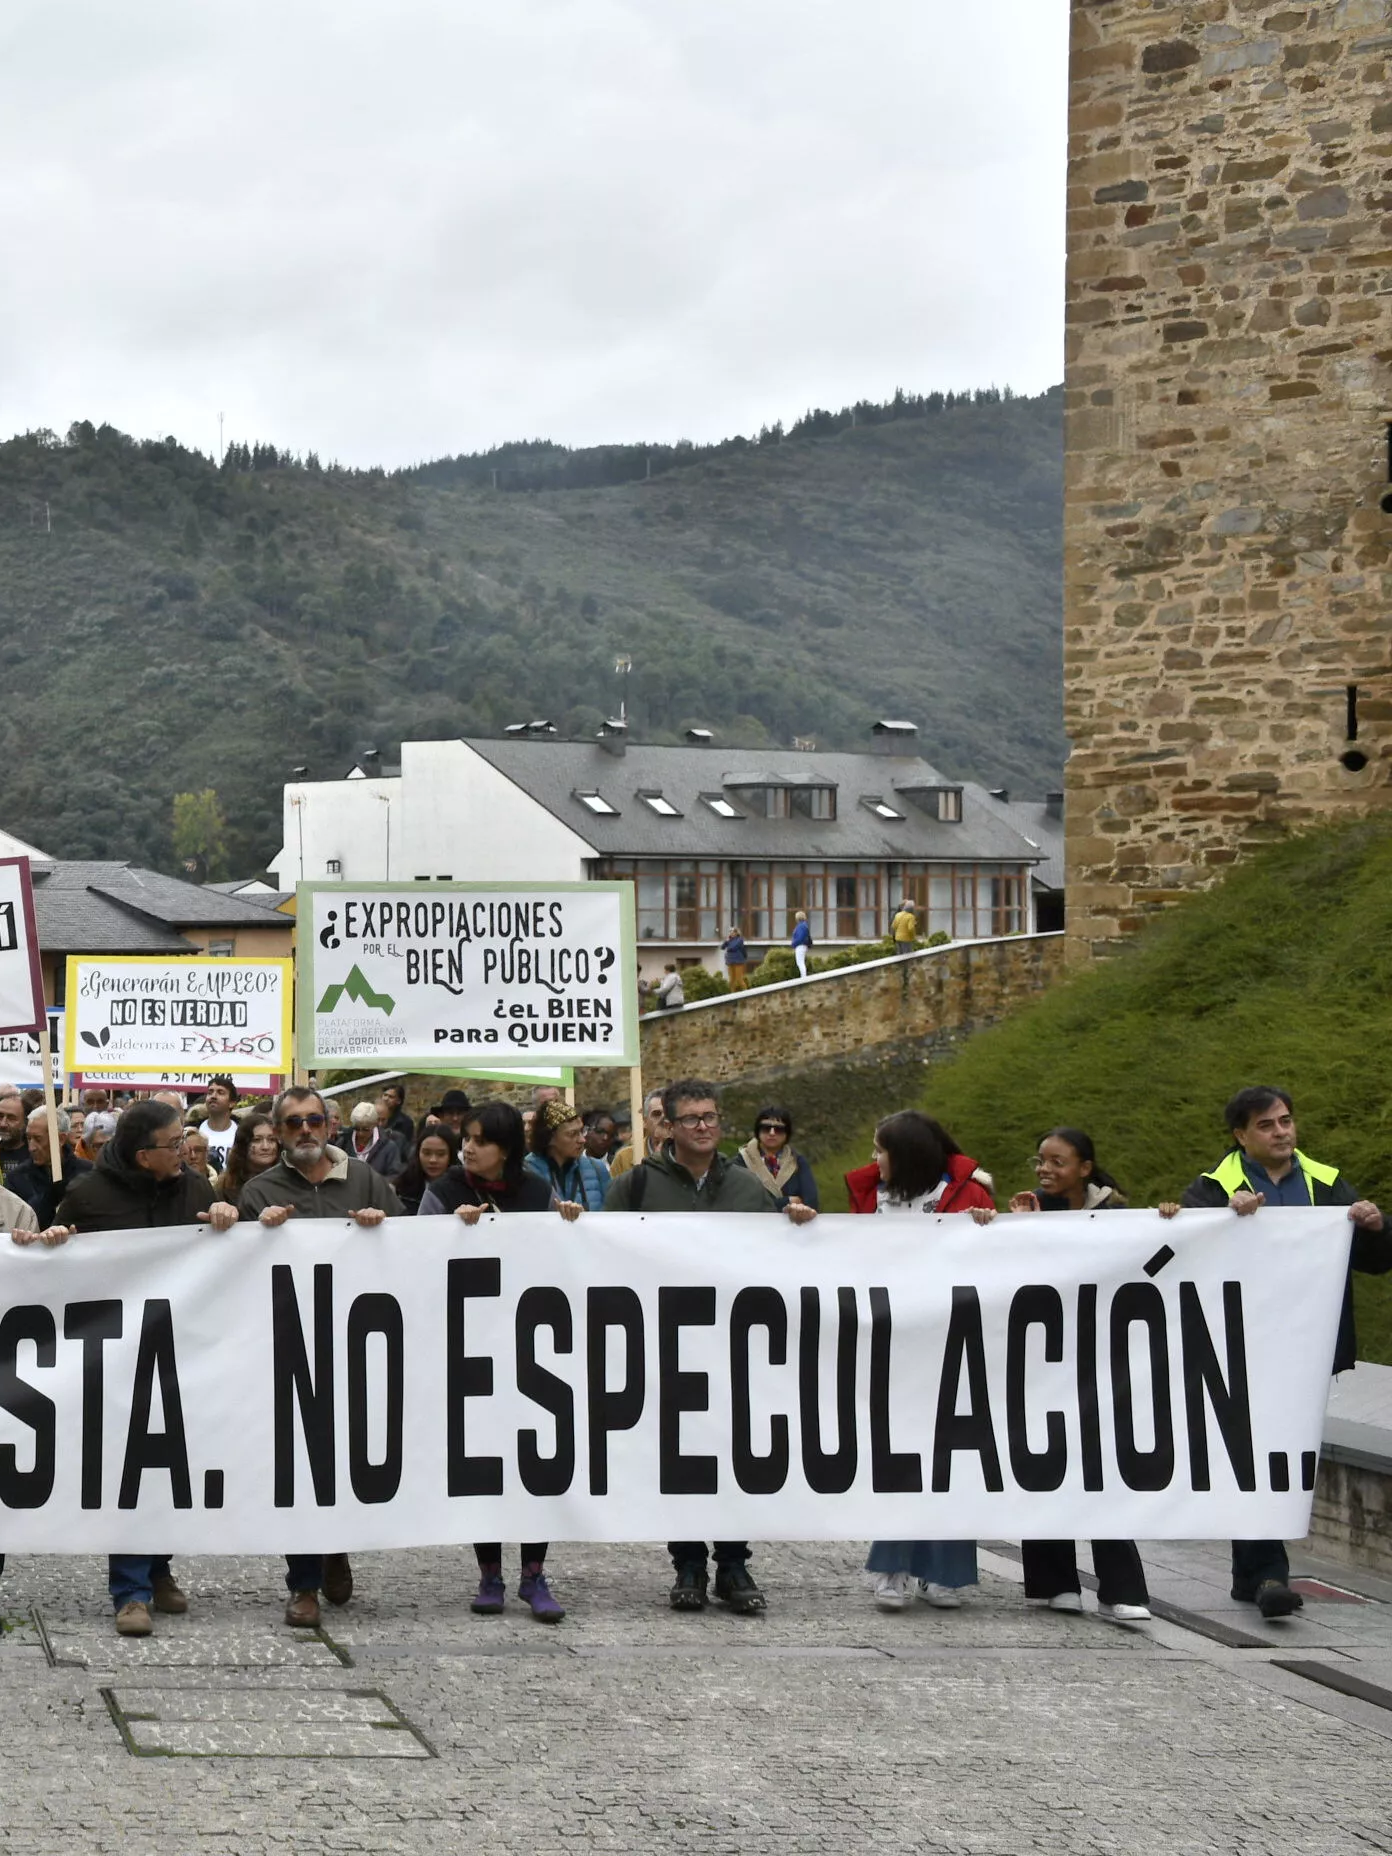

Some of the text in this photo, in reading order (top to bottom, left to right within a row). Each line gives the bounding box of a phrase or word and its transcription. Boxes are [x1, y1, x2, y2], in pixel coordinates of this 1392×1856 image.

[319, 901, 563, 949] ¿EXPROPIACIONES
[363, 943, 404, 957] POR EL
[408, 938, 472, 995] BIEN
[80, 970, 180, 999] ¿Generarán
[111, 999, 247, 1027] NO ES VERDAD
[548, 998, 612, 1018] BIEN
[180, 1037, 274, 1053] FALSO
[348, 1037, 408, 1045] CORDILLERA
[508, 1022, 614, 1048] QUIEN?
[98, 1053, 126, 1061] vive
[272, 1262, 404, 1508] NO
